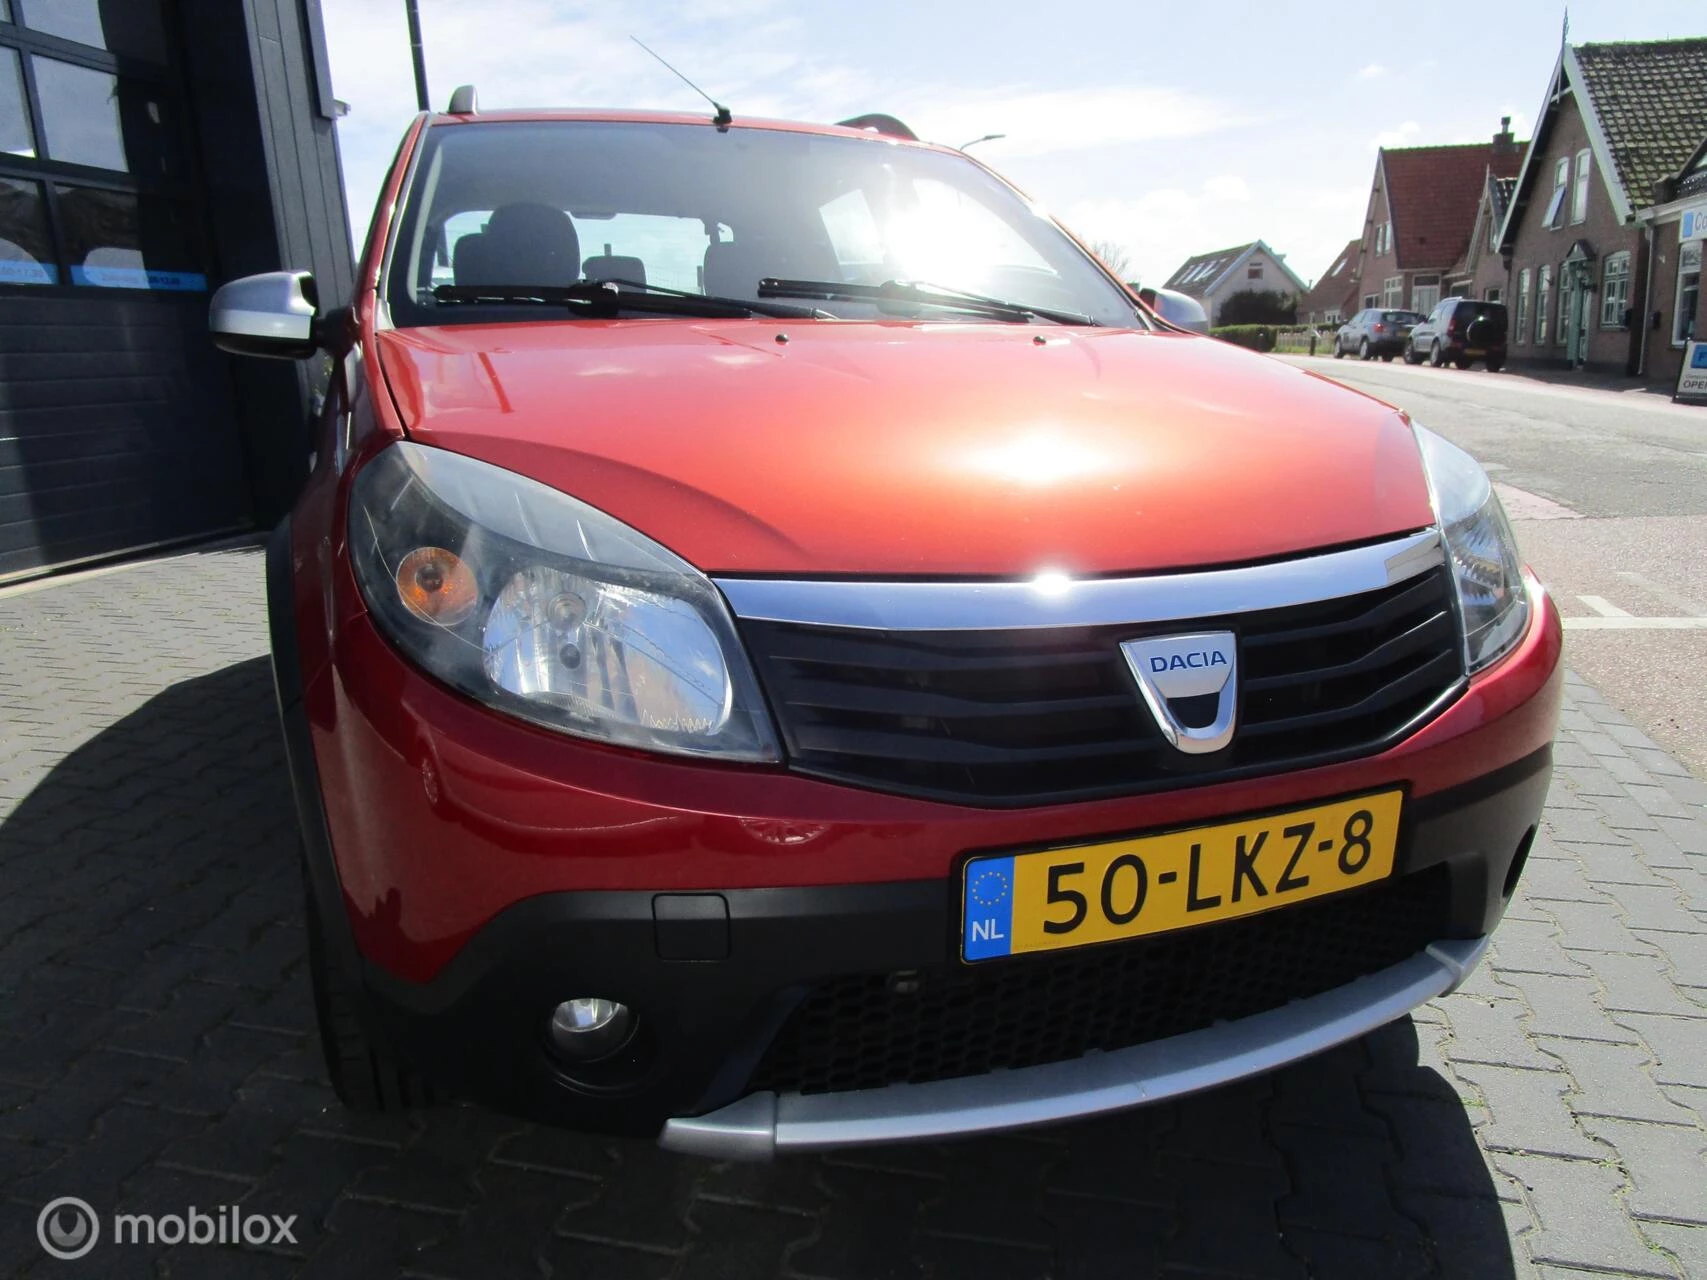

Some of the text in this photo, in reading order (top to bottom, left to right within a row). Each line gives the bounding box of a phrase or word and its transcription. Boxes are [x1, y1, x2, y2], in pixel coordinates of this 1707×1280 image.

[1150, 651, 1227, 672] DACIA
[1042, 809, 1374, 935] 50-LKZ-8
[971, 919, 1004, 942] NL
